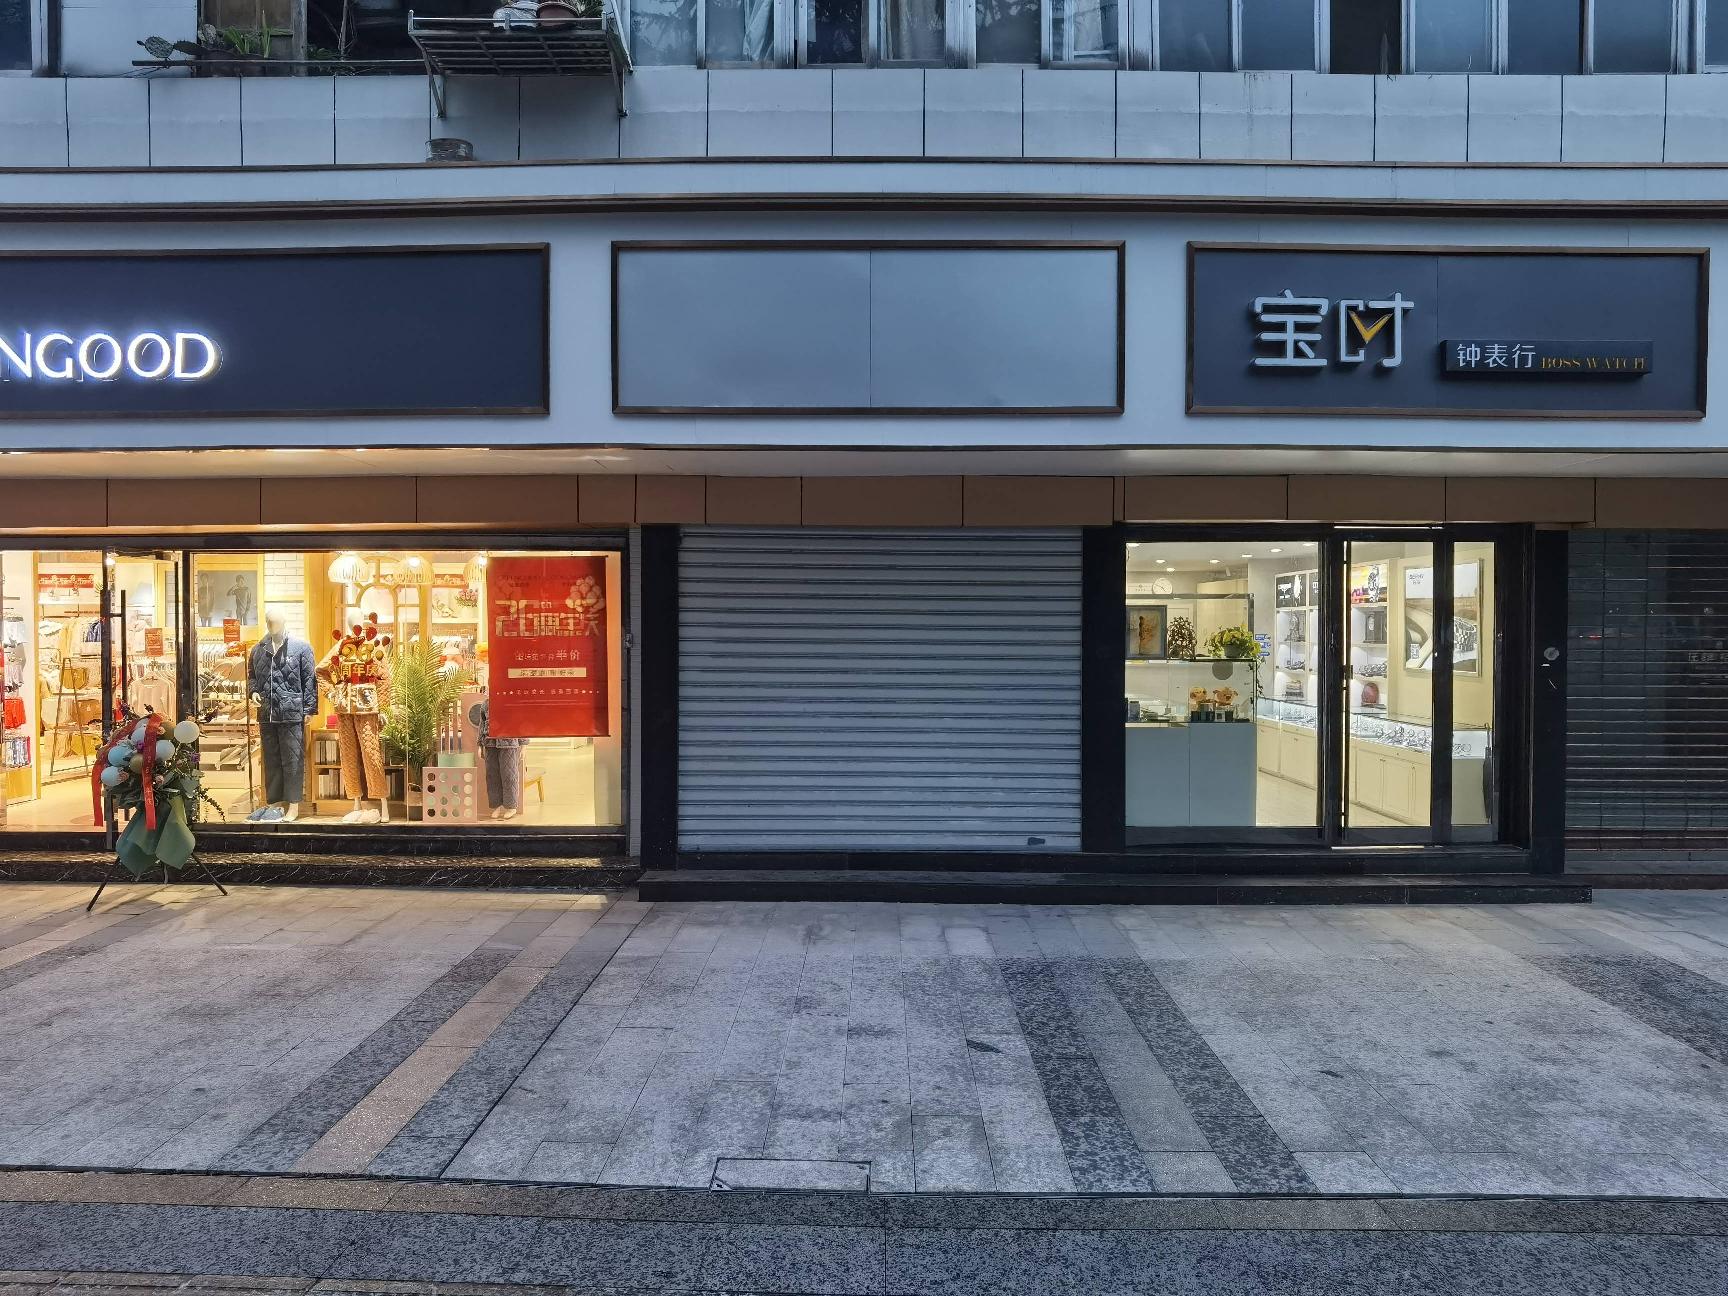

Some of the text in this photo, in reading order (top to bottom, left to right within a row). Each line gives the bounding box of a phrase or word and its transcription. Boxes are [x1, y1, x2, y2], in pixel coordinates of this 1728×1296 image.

[0, 332, 215, 378] NGOOD
[1457, 343, 1536, 368] 钟表行
[1542, 357, 1645, 369] BOSS WATCH
[341, 643, 375, 662] 26
[340, 664, 379, 677] 周年庆
